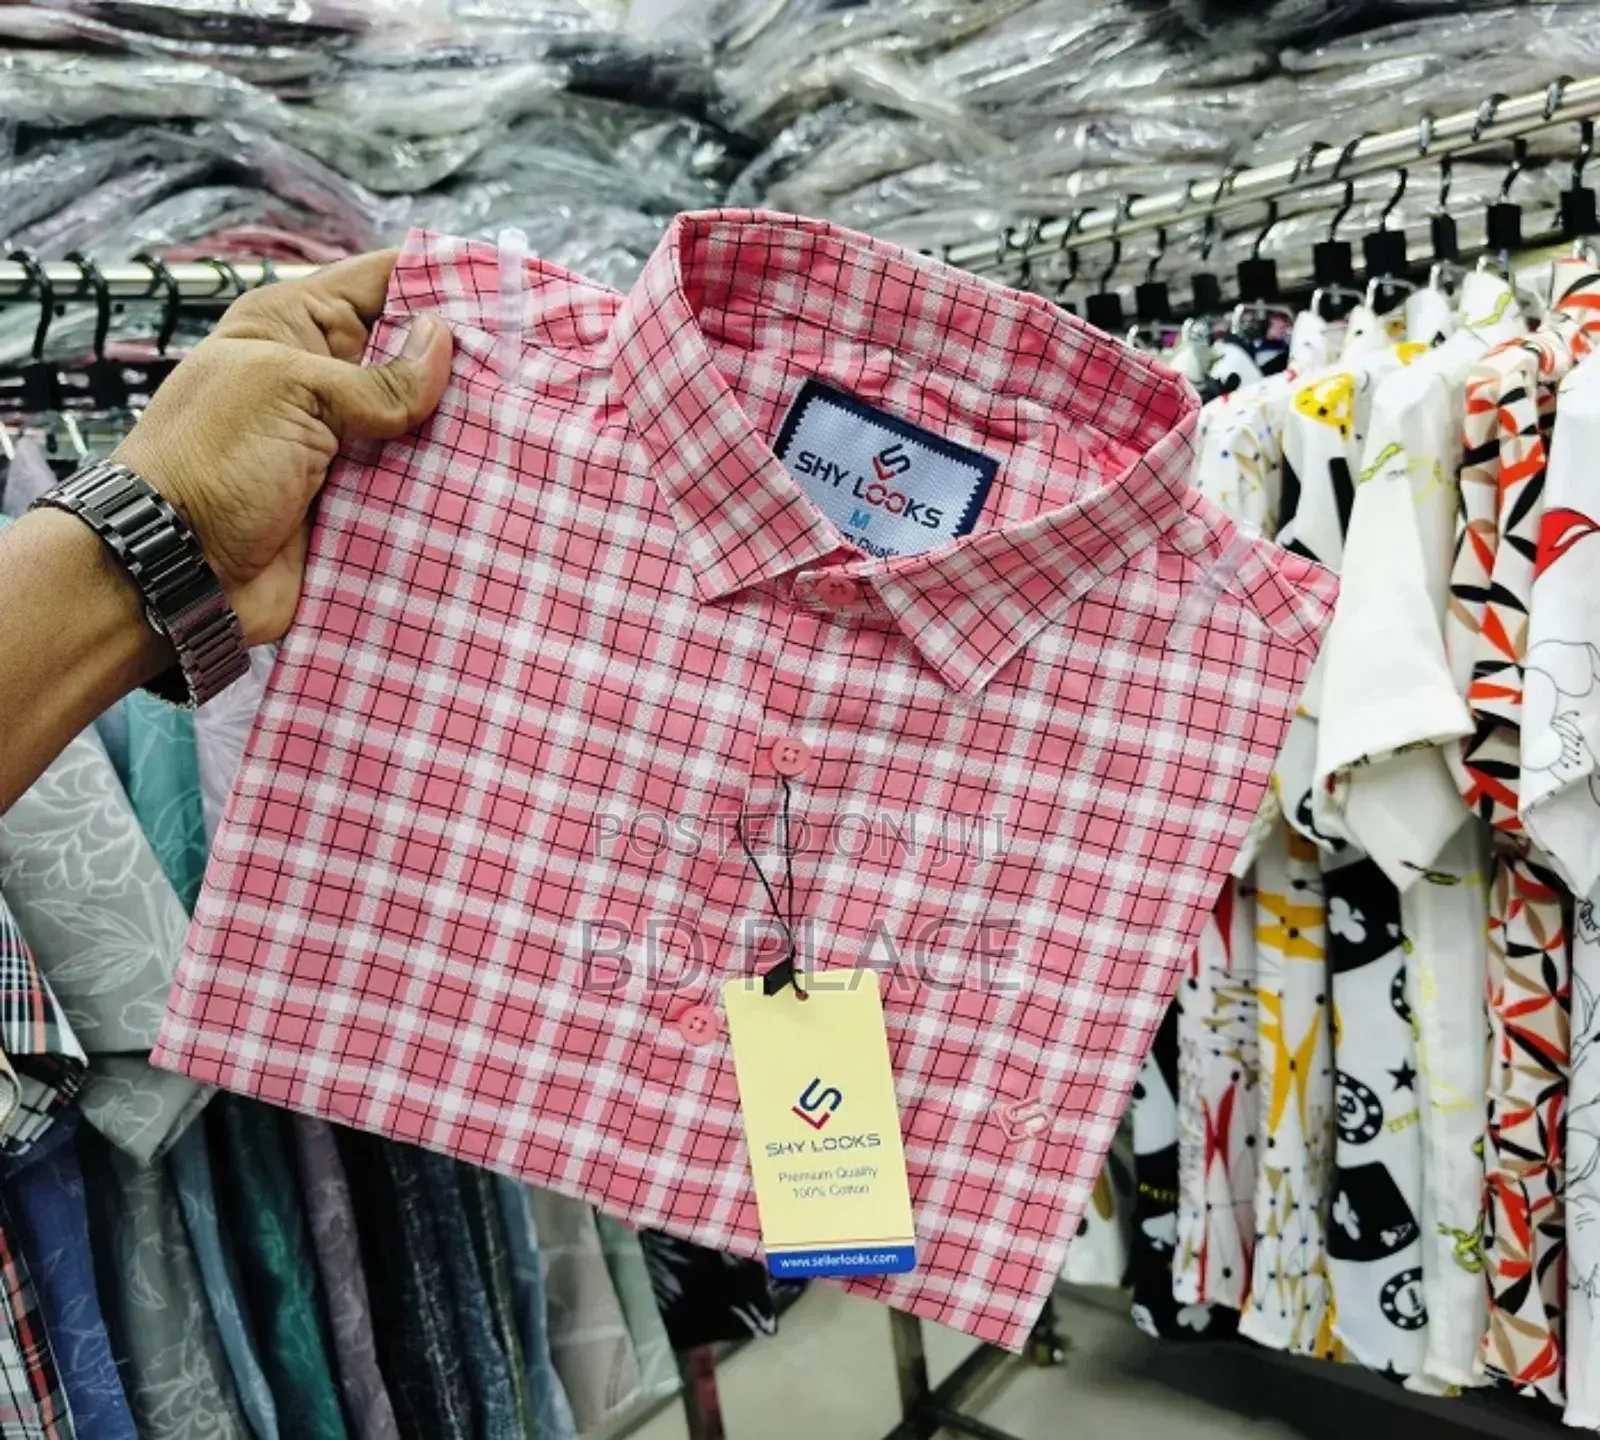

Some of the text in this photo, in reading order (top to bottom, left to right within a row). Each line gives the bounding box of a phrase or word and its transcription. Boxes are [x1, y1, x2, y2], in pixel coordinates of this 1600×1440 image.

[794, 451, 944, 529] SHY LOOKS
[848, 508, 872, 530] M
[765, 1133, 881, 1157] SHY LOOKS
[778, 1165, 879, 1183] Premium Quality
[793, 1183, 870, 1199] 100% Cotton
